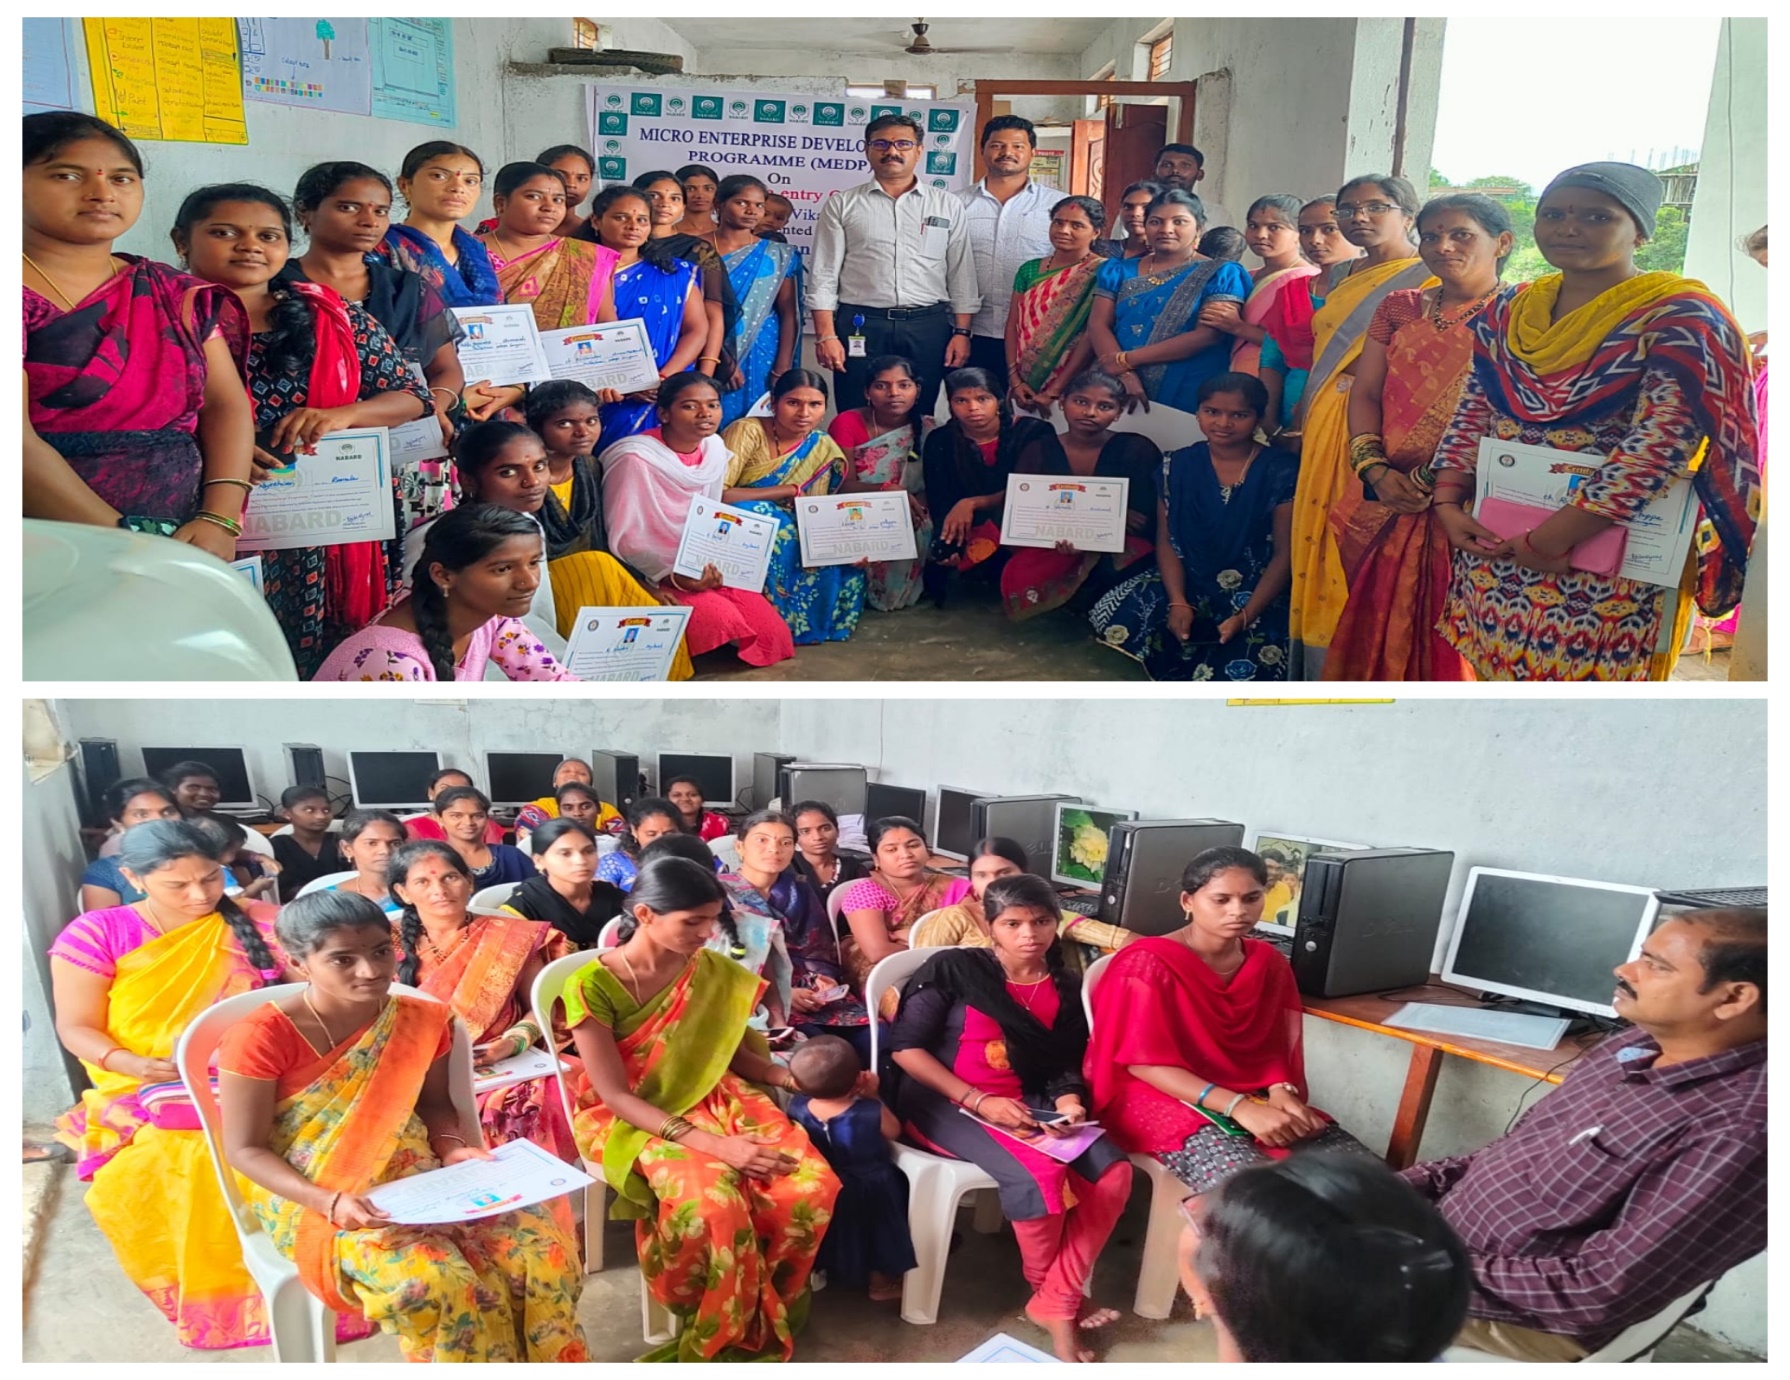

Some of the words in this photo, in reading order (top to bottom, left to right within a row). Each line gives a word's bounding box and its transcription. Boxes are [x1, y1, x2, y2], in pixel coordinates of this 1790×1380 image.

[639, 127, 694, 143] MICRO
[699, 131, 797, 149] ENTERPRISE
[688, 150, 806, 168] PROGRAMME
[767, 172, 791, 185] On
[781, 189, 823, 204] entry
[778, 225, 813, 236] nted
